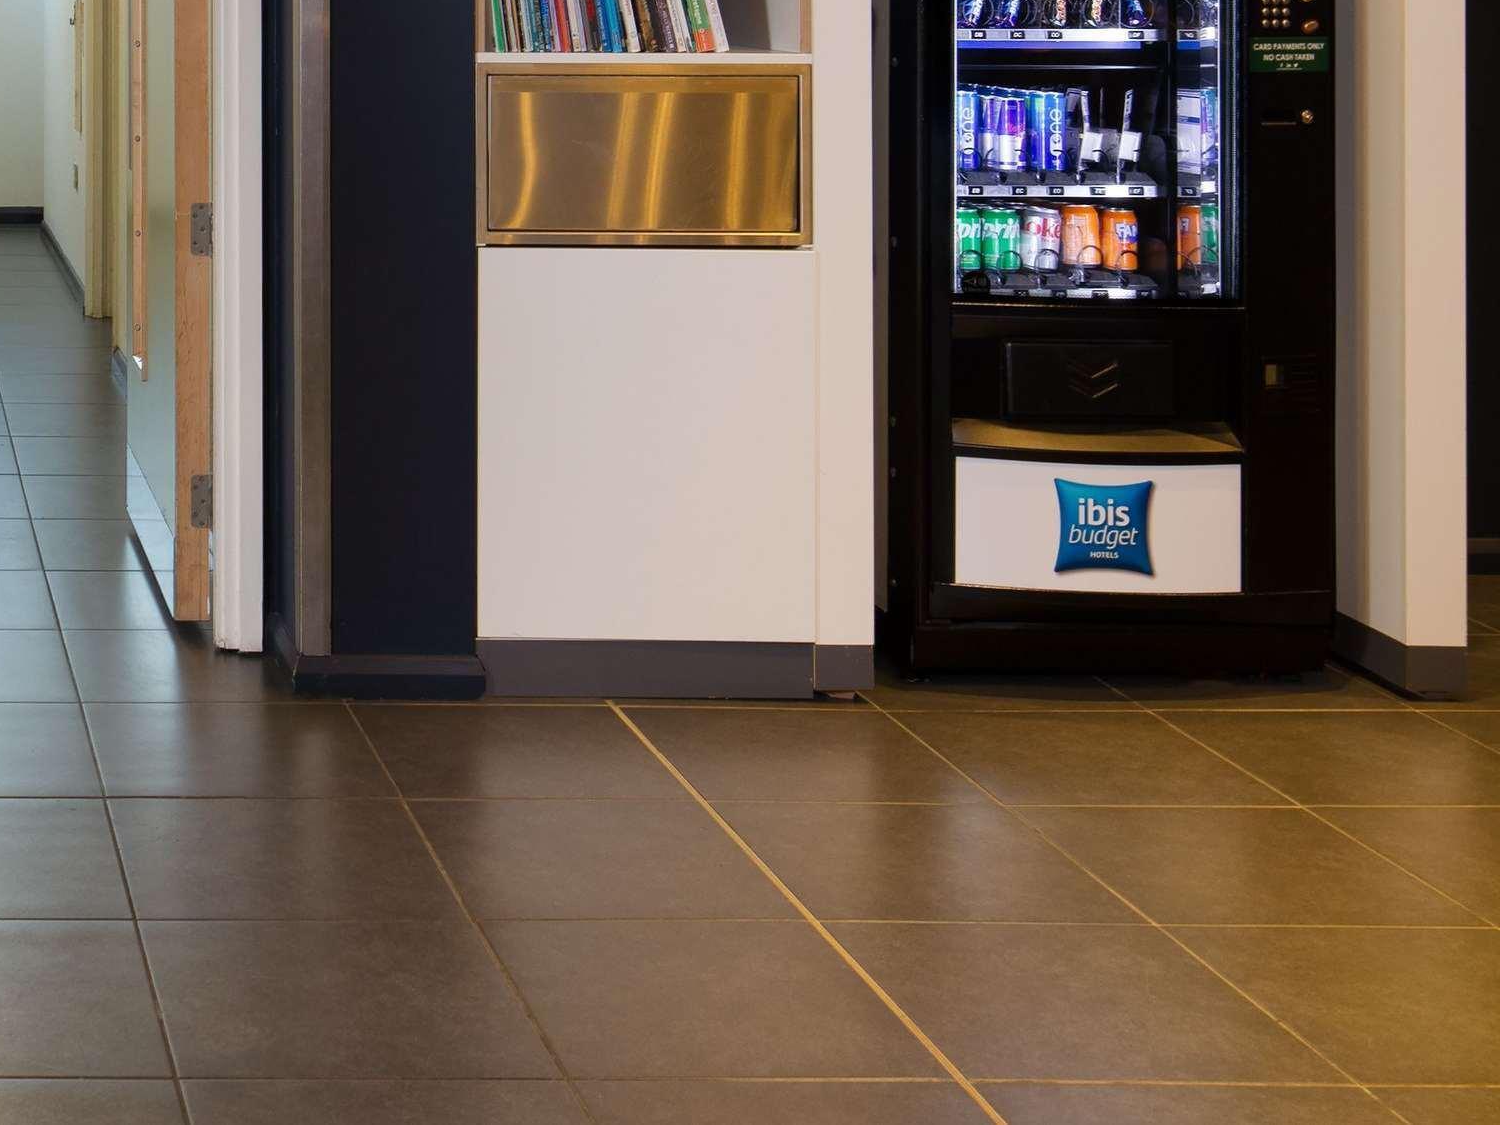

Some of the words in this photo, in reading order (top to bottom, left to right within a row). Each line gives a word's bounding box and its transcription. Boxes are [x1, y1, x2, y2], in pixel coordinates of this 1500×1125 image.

[1307, 42, 1325, 50] ONLY
[1078, 498, 1131, 526] ibis
[1069, 525, 1139, 550] budget
[1090, 551, 1119, 559] HOTELS
